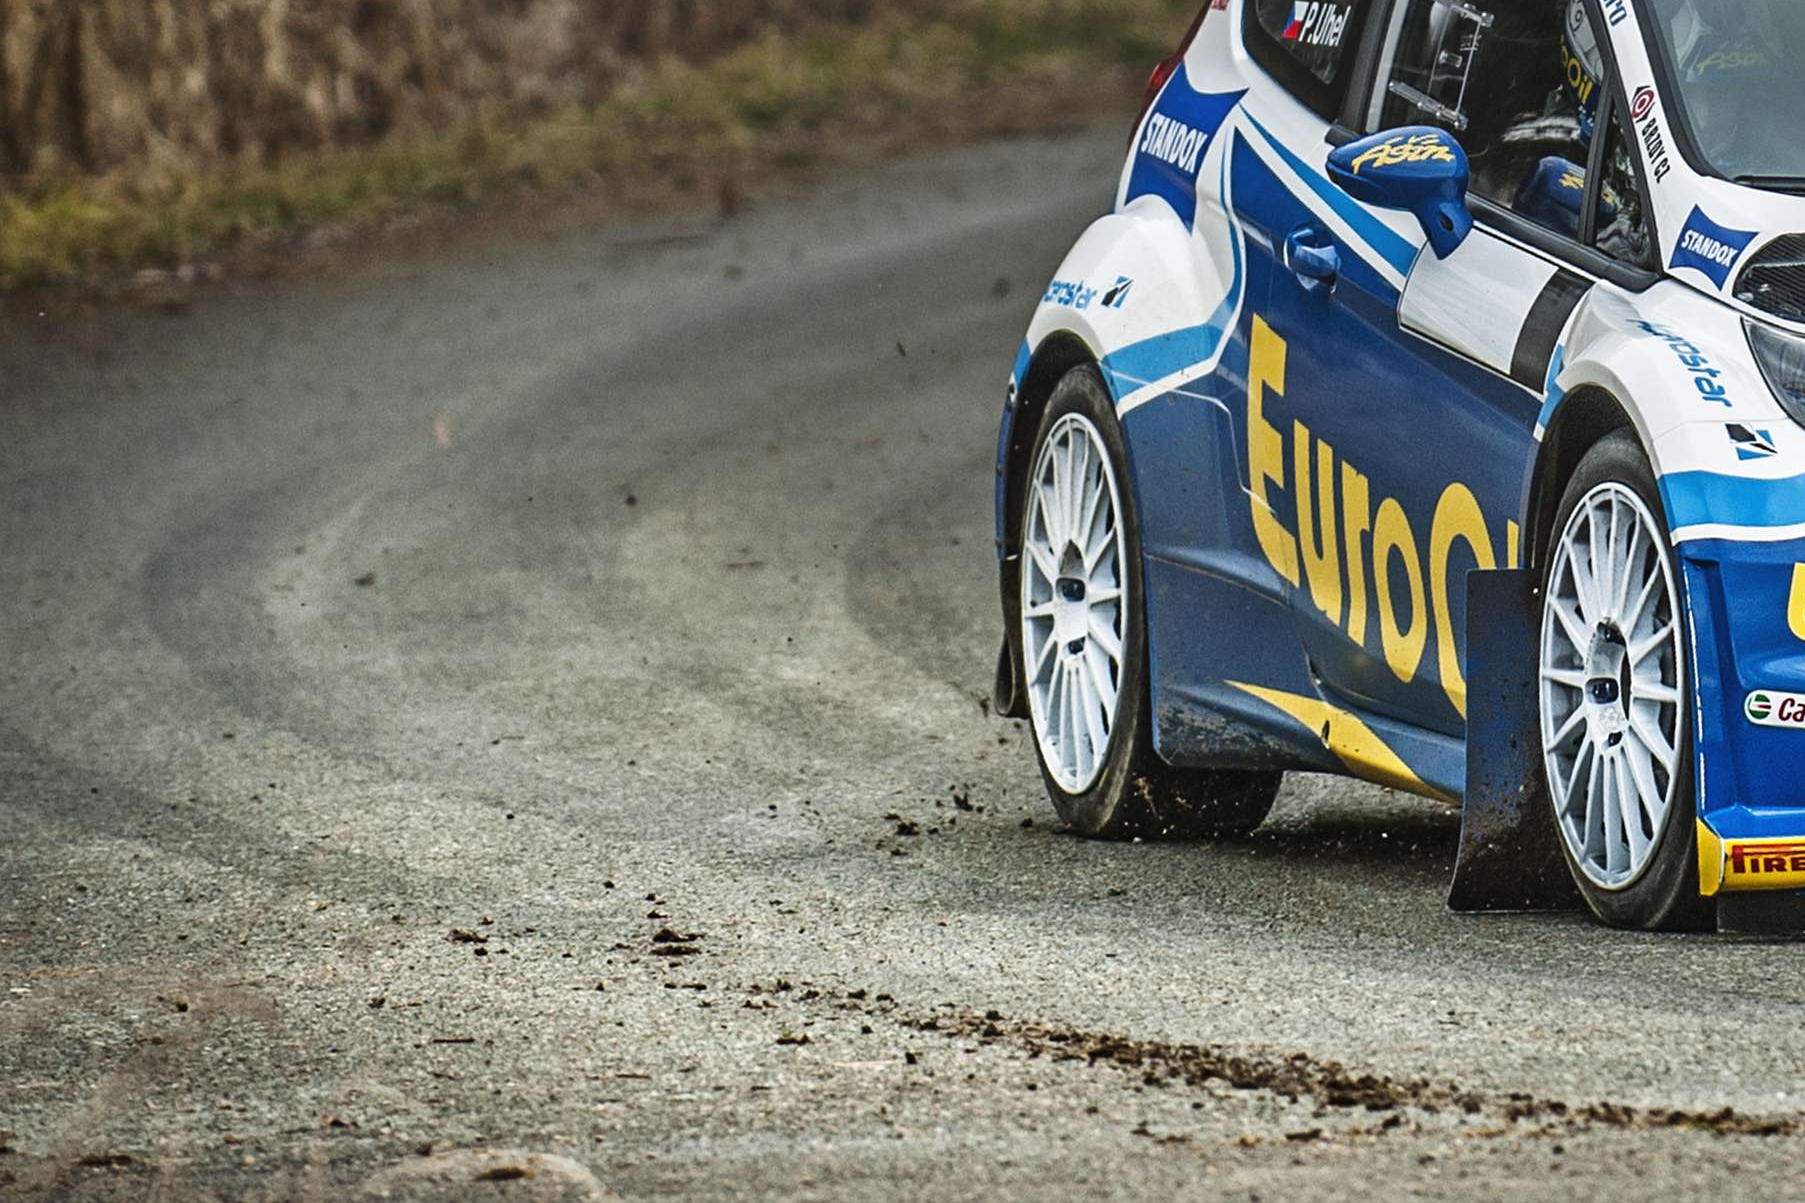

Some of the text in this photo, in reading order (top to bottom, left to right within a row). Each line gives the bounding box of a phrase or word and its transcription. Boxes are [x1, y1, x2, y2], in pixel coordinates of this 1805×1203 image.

[1298, 1, 1351, 47] P.Uhel
[1141, 113, 1207, 173] STANDOX
[1681, 230, 1738, 268] STANDOX
